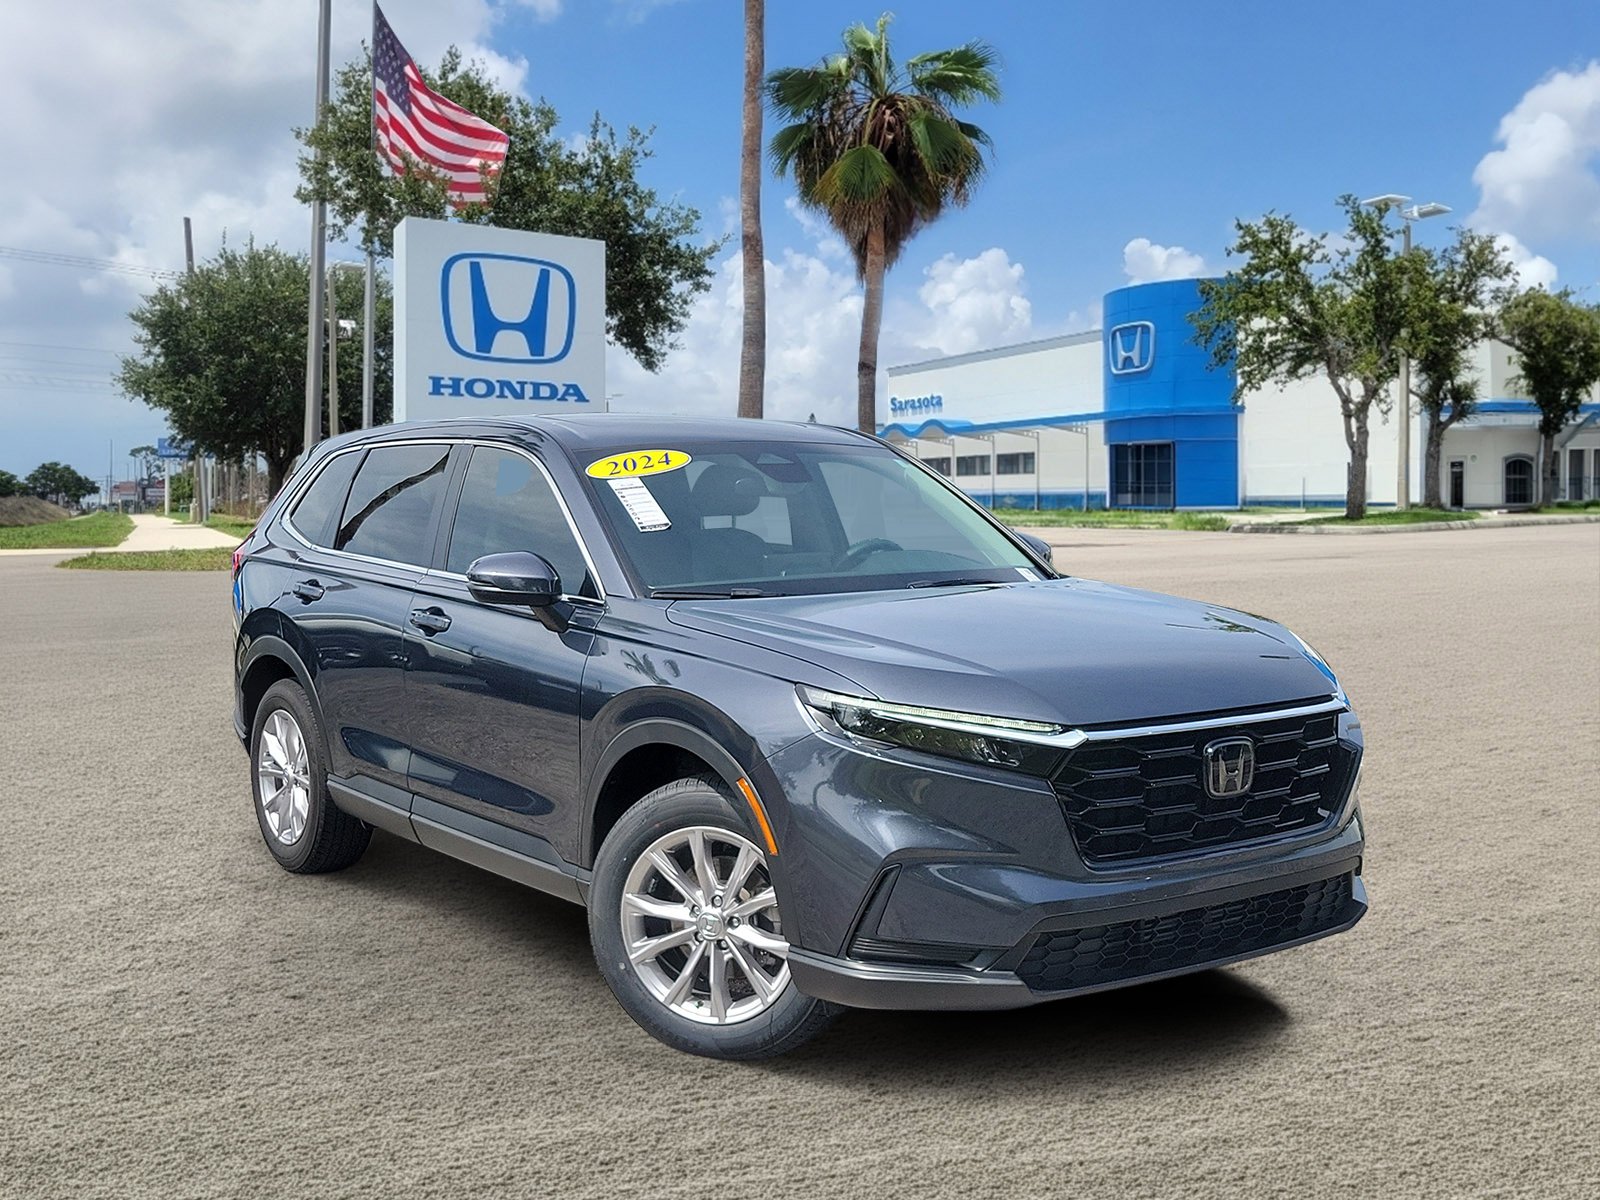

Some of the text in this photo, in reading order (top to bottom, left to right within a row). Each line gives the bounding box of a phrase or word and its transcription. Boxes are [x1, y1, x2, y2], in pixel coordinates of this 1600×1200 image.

[428, 375, 590, 403] HONDA
[890, 393, 943, 412] Sarasota
[606, 452, 672, 476] 2024
